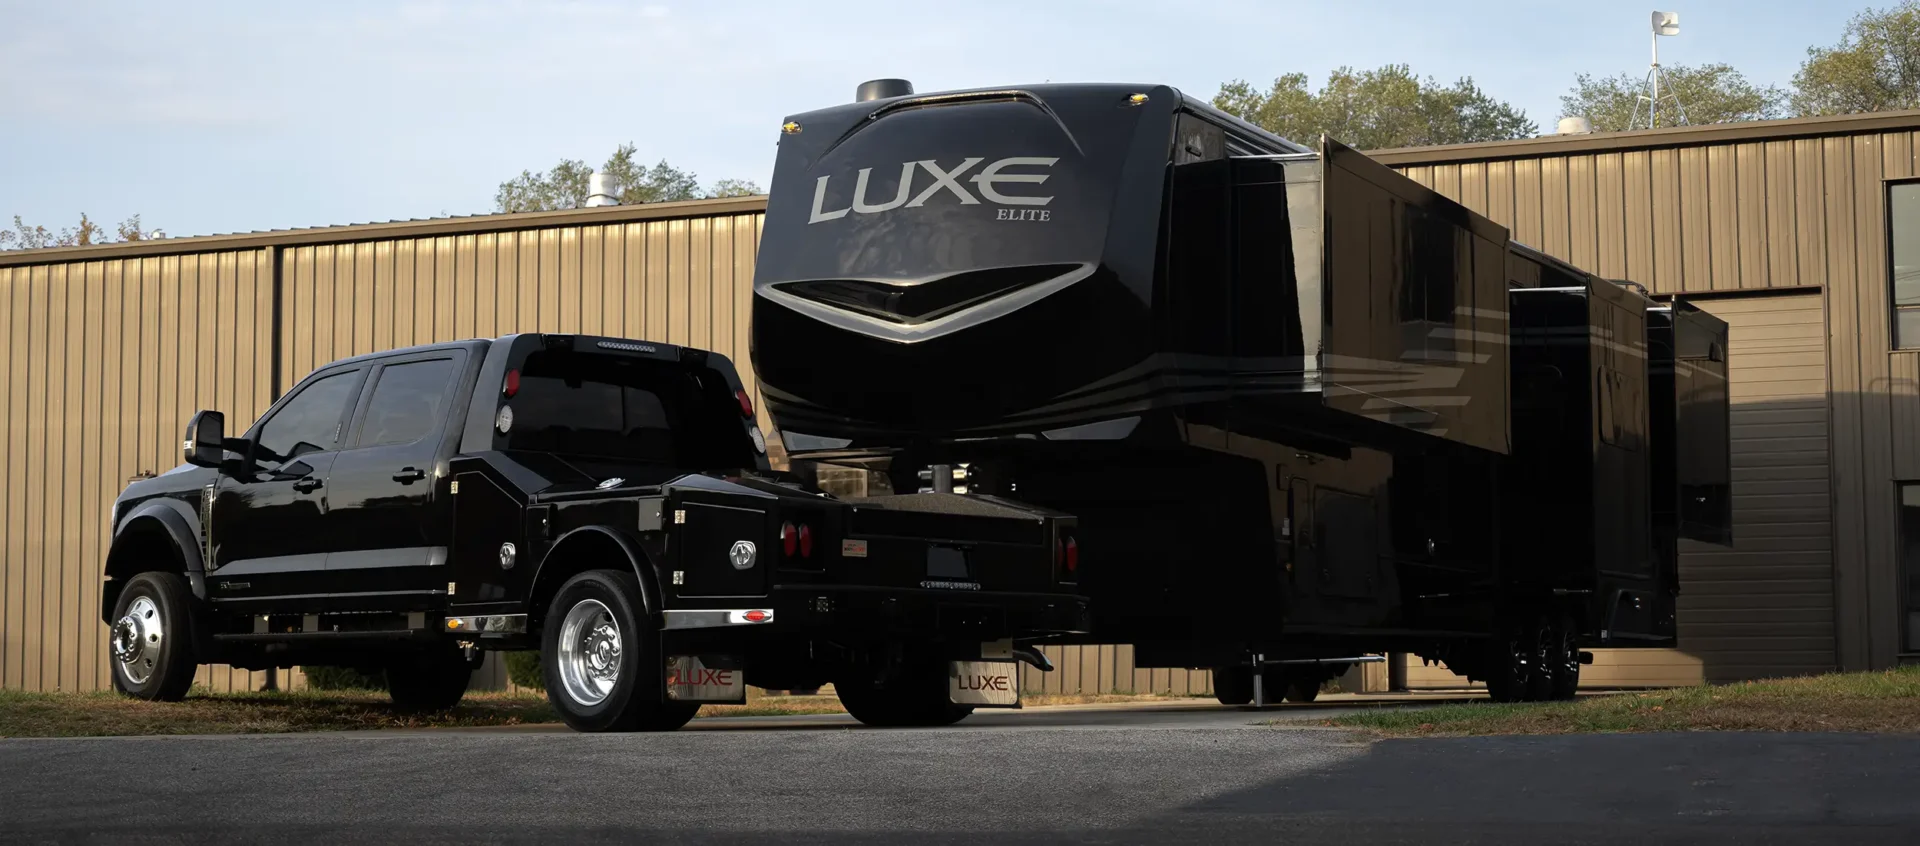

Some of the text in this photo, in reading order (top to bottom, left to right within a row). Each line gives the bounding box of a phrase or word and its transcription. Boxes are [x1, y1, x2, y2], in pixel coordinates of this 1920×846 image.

[808, 157, 1060, 224] LUXE
[996, 208, 1051, 222] ELITE
[676, 669, 733, 686] LUXE
[958, 675, 1008, 691] LUXE
